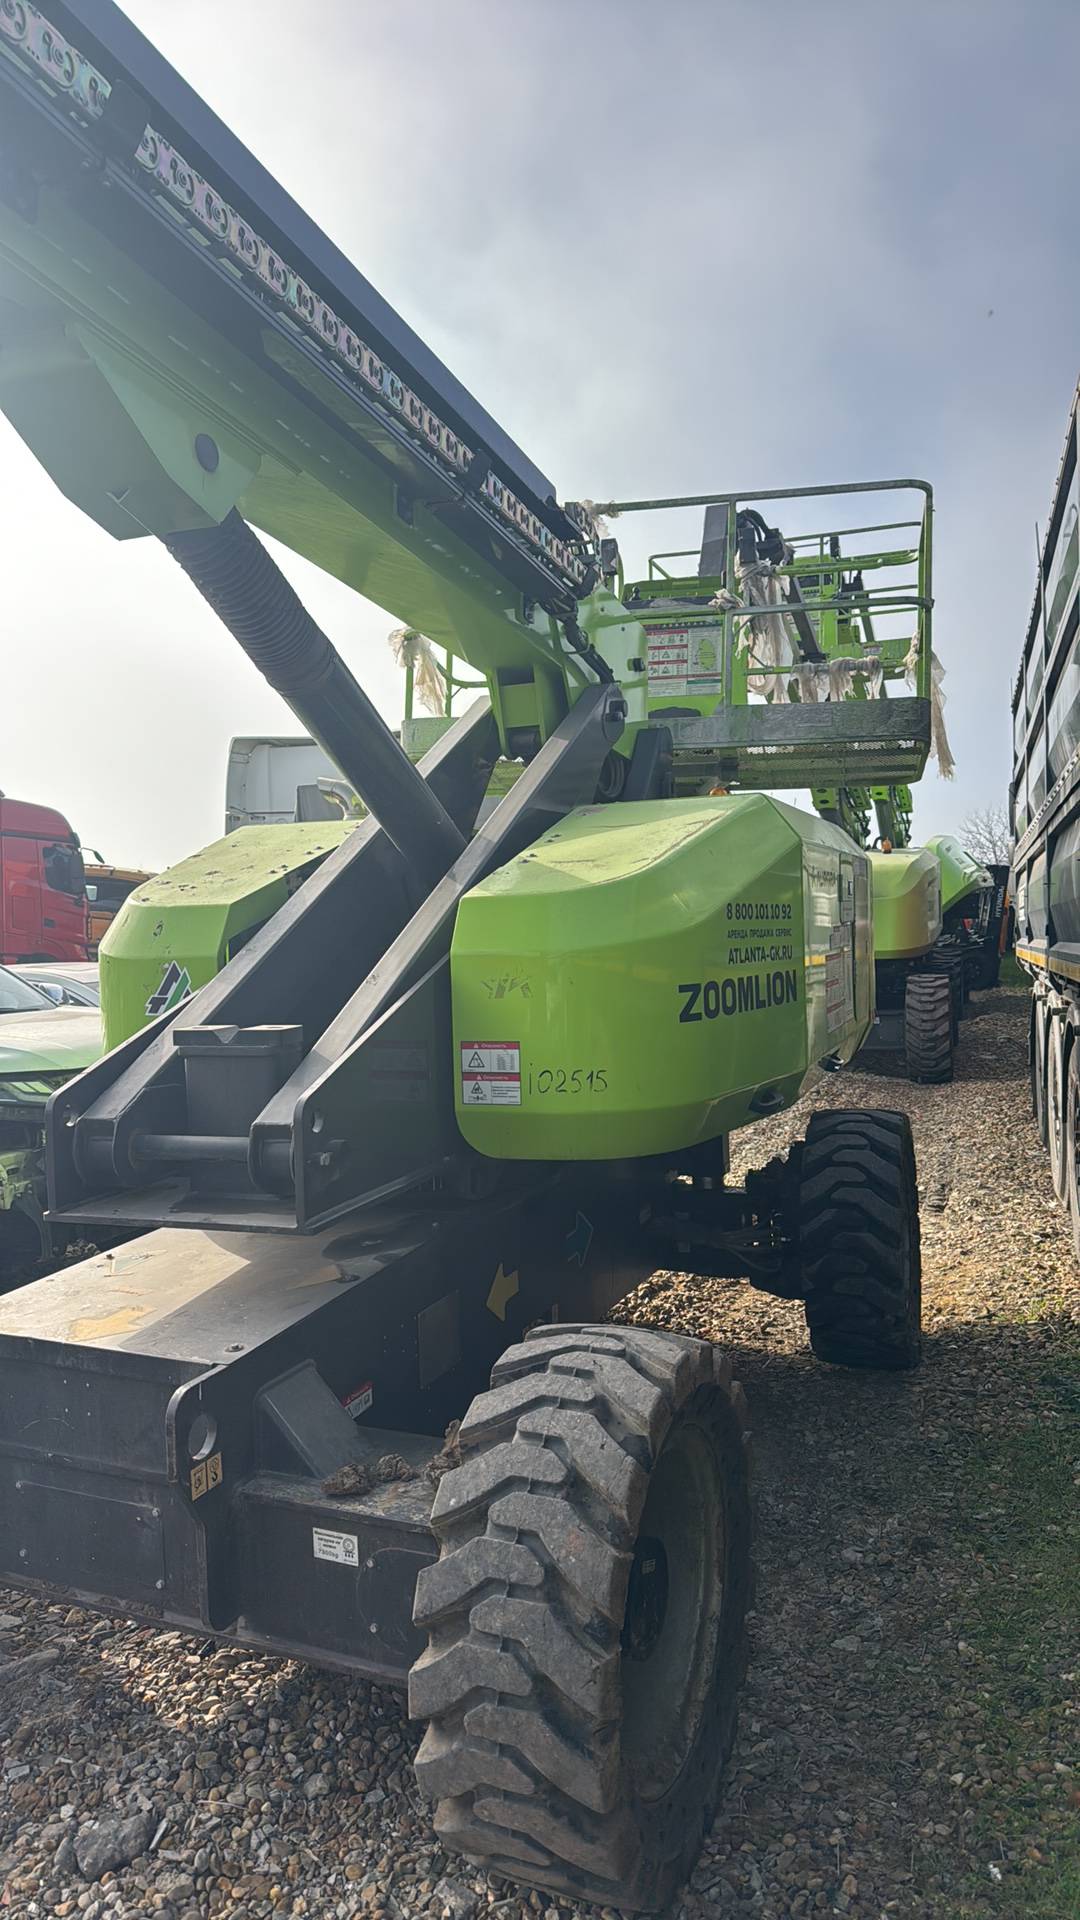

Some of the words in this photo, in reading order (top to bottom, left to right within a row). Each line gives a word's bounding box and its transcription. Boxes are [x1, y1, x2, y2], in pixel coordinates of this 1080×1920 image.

[726, 902, 733, 920] 8
[735, 902, 754, 920] 800
[755, 903, 769, 920] 101
[781, 903, 792, 920] 92
[727, 929, 748, 939] АРЕНДА
[749, 929, 774, 939] ПРОДАЖА
[775, 928, 792, 937] СЕРВИС
[728, 945, 793, 965] ATLANTA-GK.RU
[678, 969, 797, 1023] ZOOMLION
